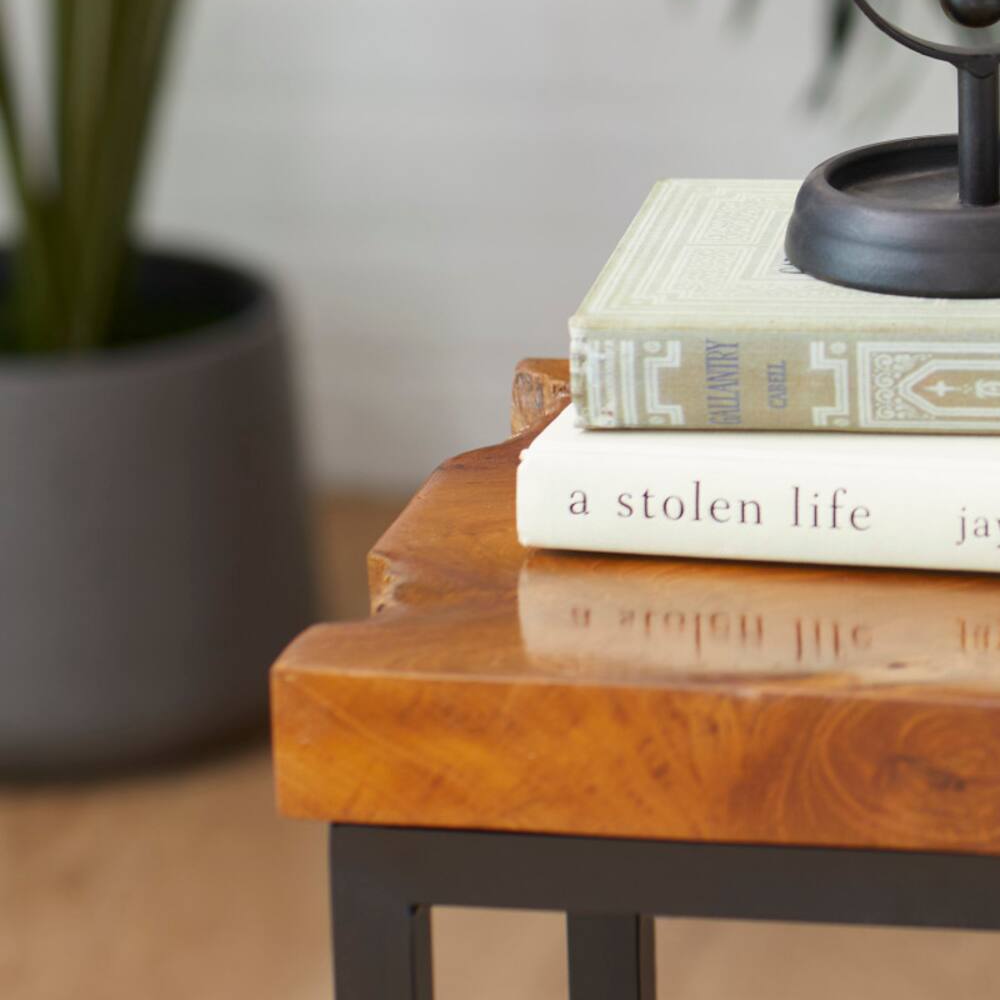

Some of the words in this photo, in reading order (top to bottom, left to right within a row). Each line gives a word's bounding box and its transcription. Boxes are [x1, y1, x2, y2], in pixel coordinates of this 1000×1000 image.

[704, 337, 741, 424] GALLANTRY
[767, 360, 786, 409] CABELL
[568, 488, 590, 516] a
[616, 480, 763, 525] stolen
[792, 486, 872, 531] life
